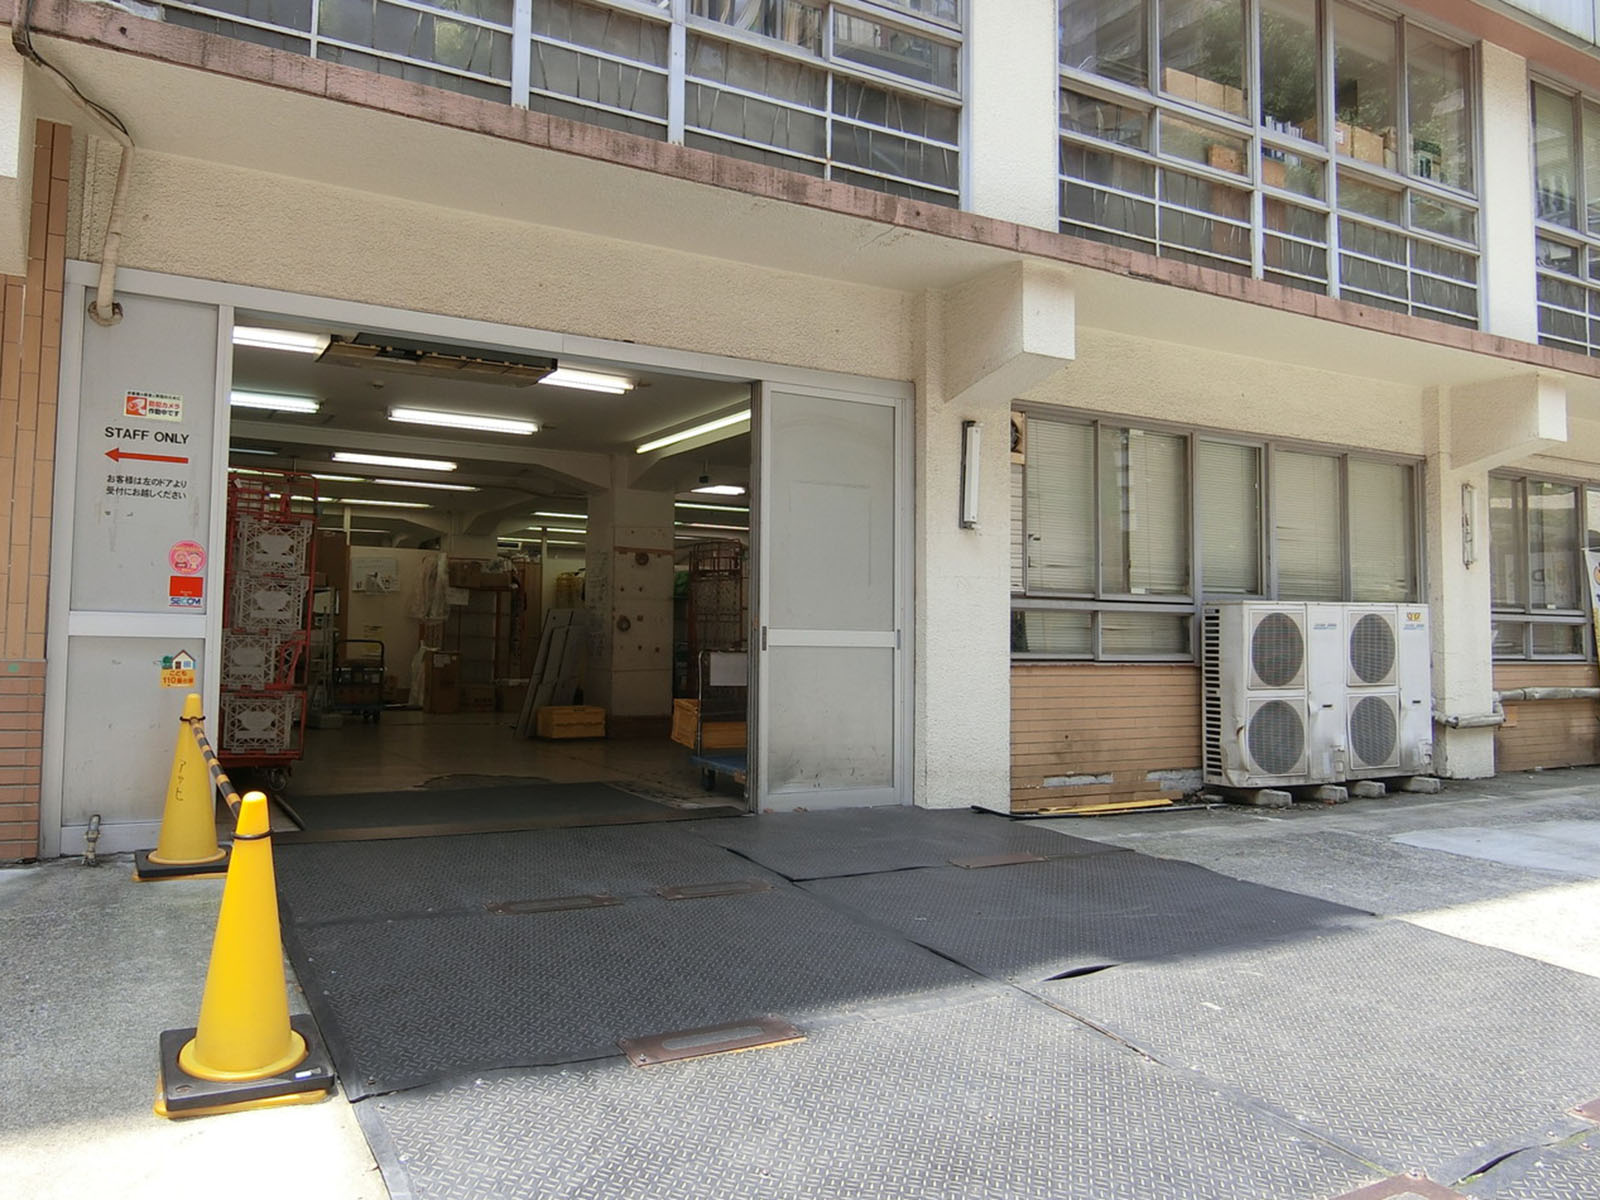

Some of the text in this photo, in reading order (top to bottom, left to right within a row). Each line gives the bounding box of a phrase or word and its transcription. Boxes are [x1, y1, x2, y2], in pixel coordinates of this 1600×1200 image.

[104, 426, 190, 445] STAFF ONLY
[106, 474, 188, 489] お客様は左のドアより
[105, 485, 187, 500] 受付にお越しください
